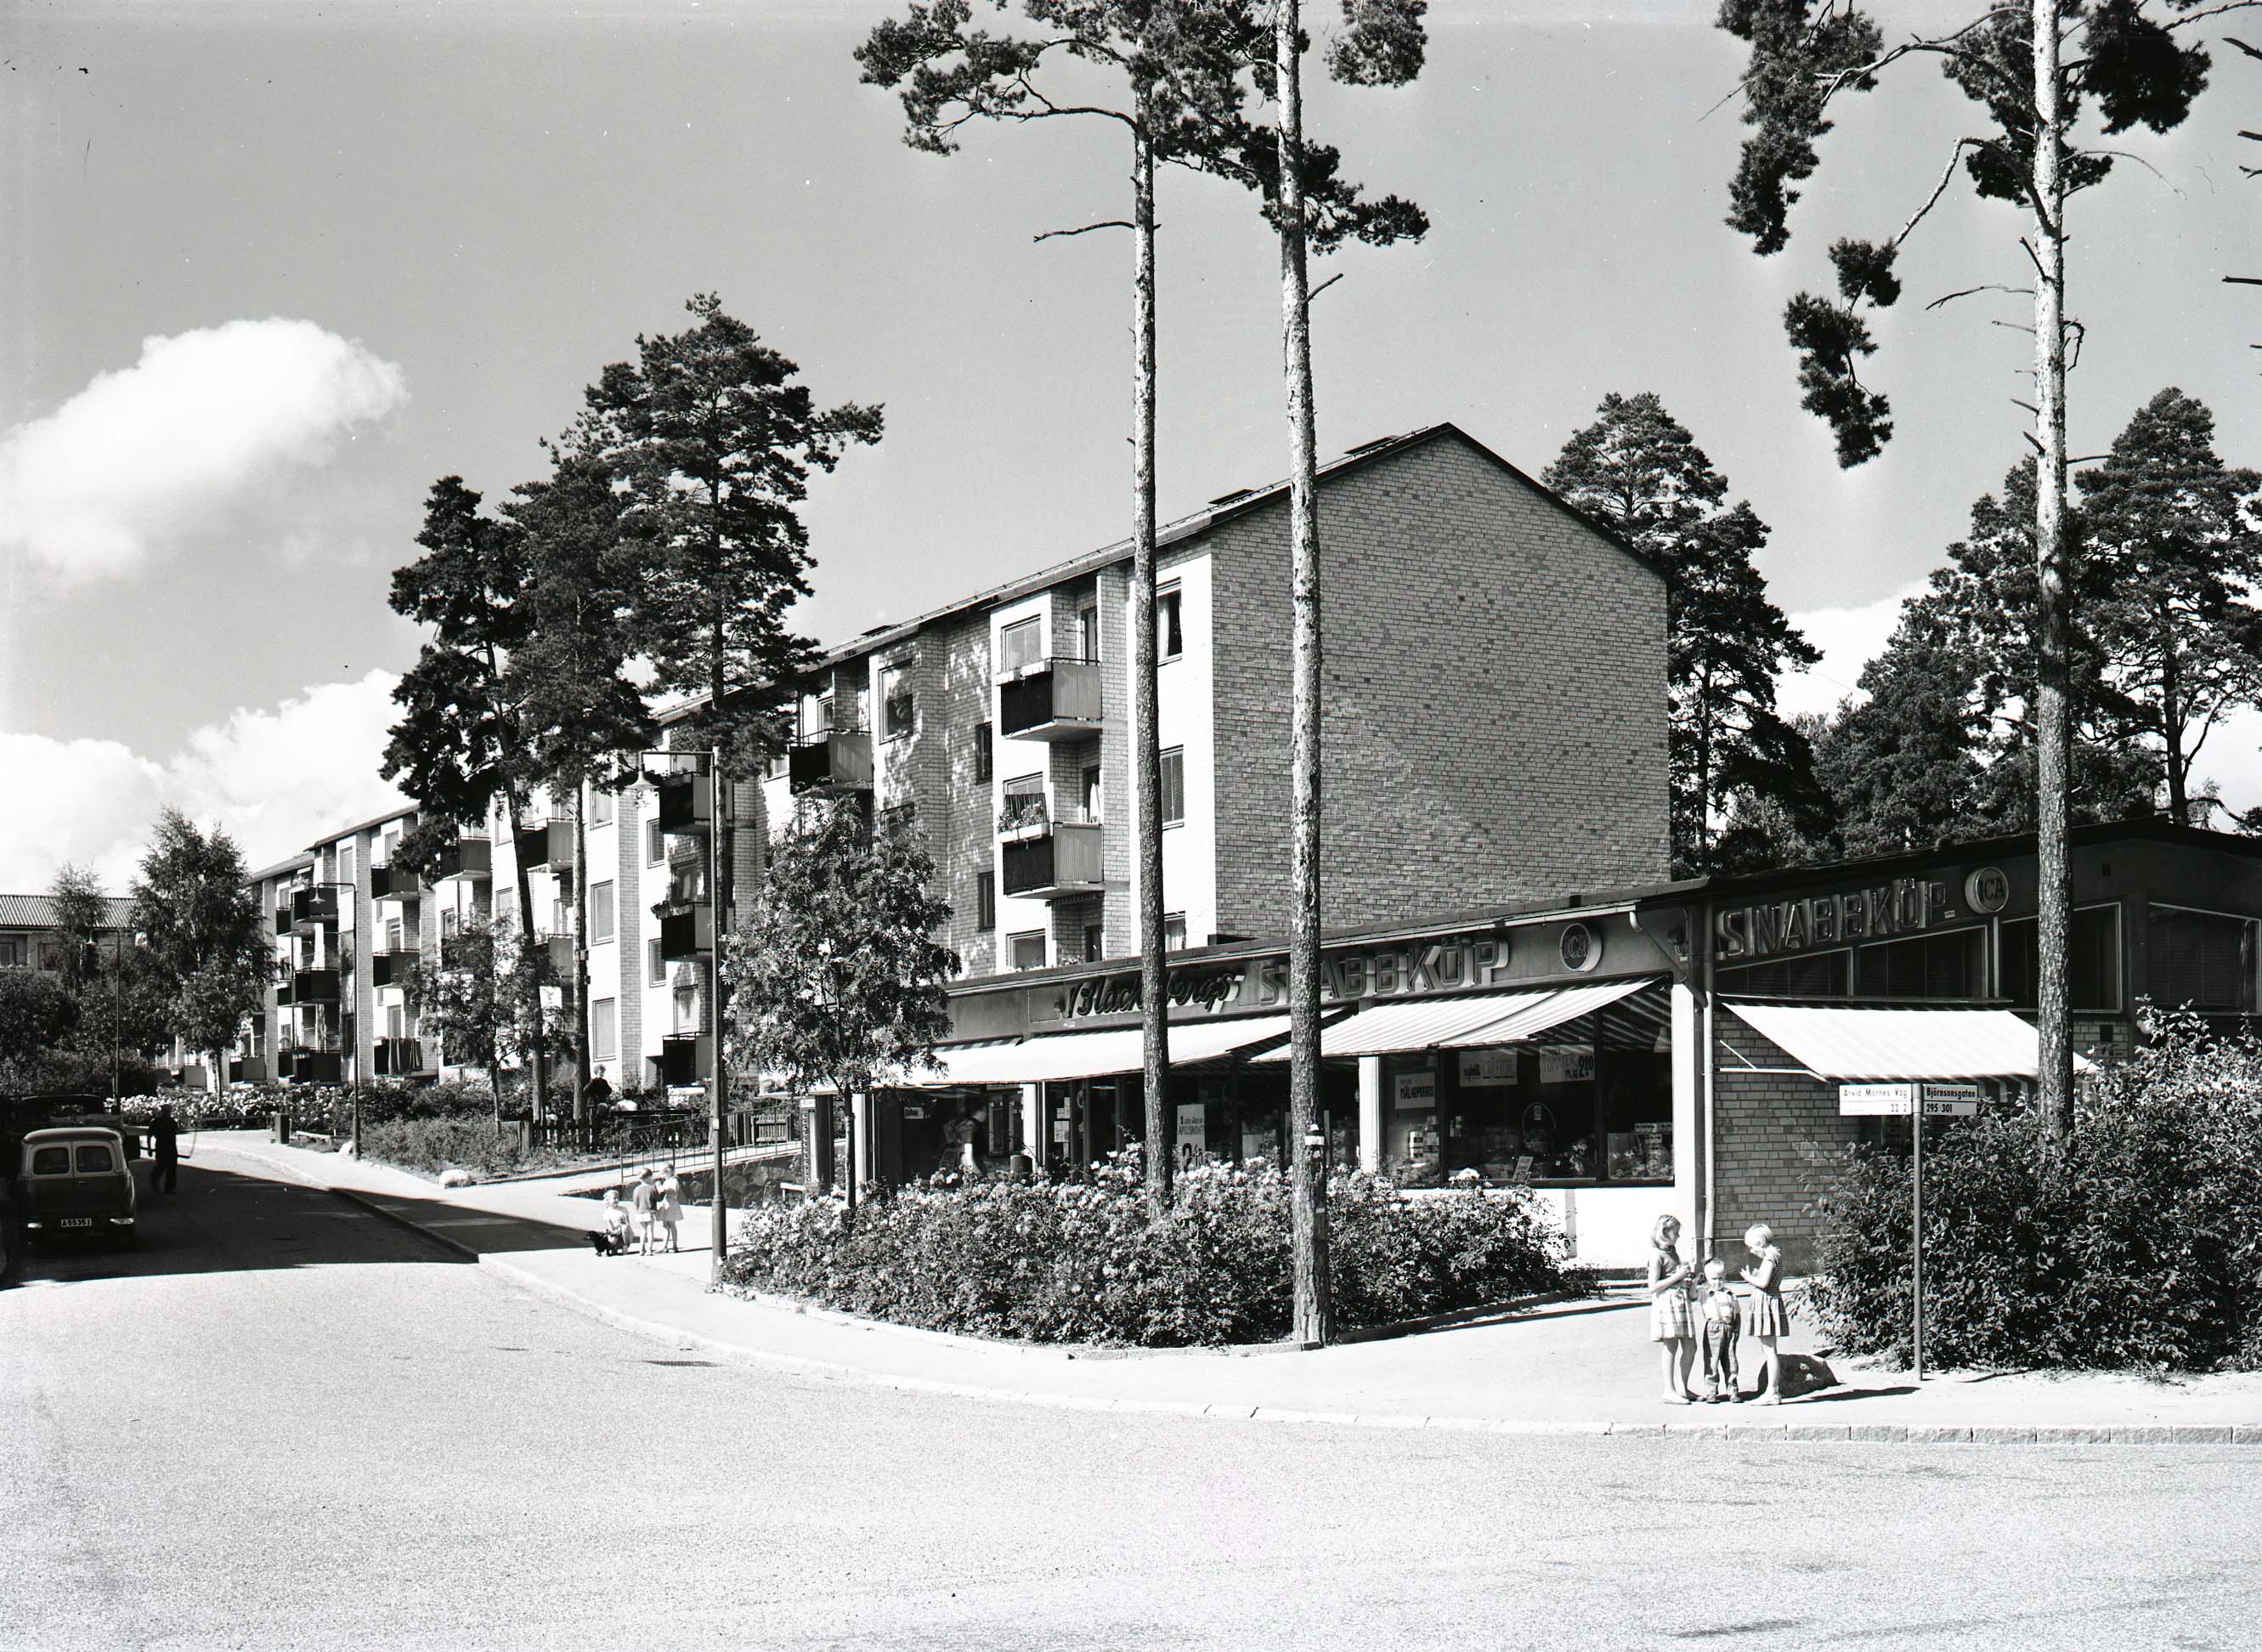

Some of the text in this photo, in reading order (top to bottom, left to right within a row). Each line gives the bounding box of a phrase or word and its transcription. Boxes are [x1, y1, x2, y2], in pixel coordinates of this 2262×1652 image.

[1981, 876, 2005, 901] ICA
[1718, 877, 1947, 959] SNABBKÖP
[1563, 935, 1588, 959] ICA
[1067, 936, 1507, 1019] Blackbergs SABBKÖP
[1843, 1088, 1862, 1097] Arvid
[1926, 1087, 1976, 1100] Björnsonsgatan
